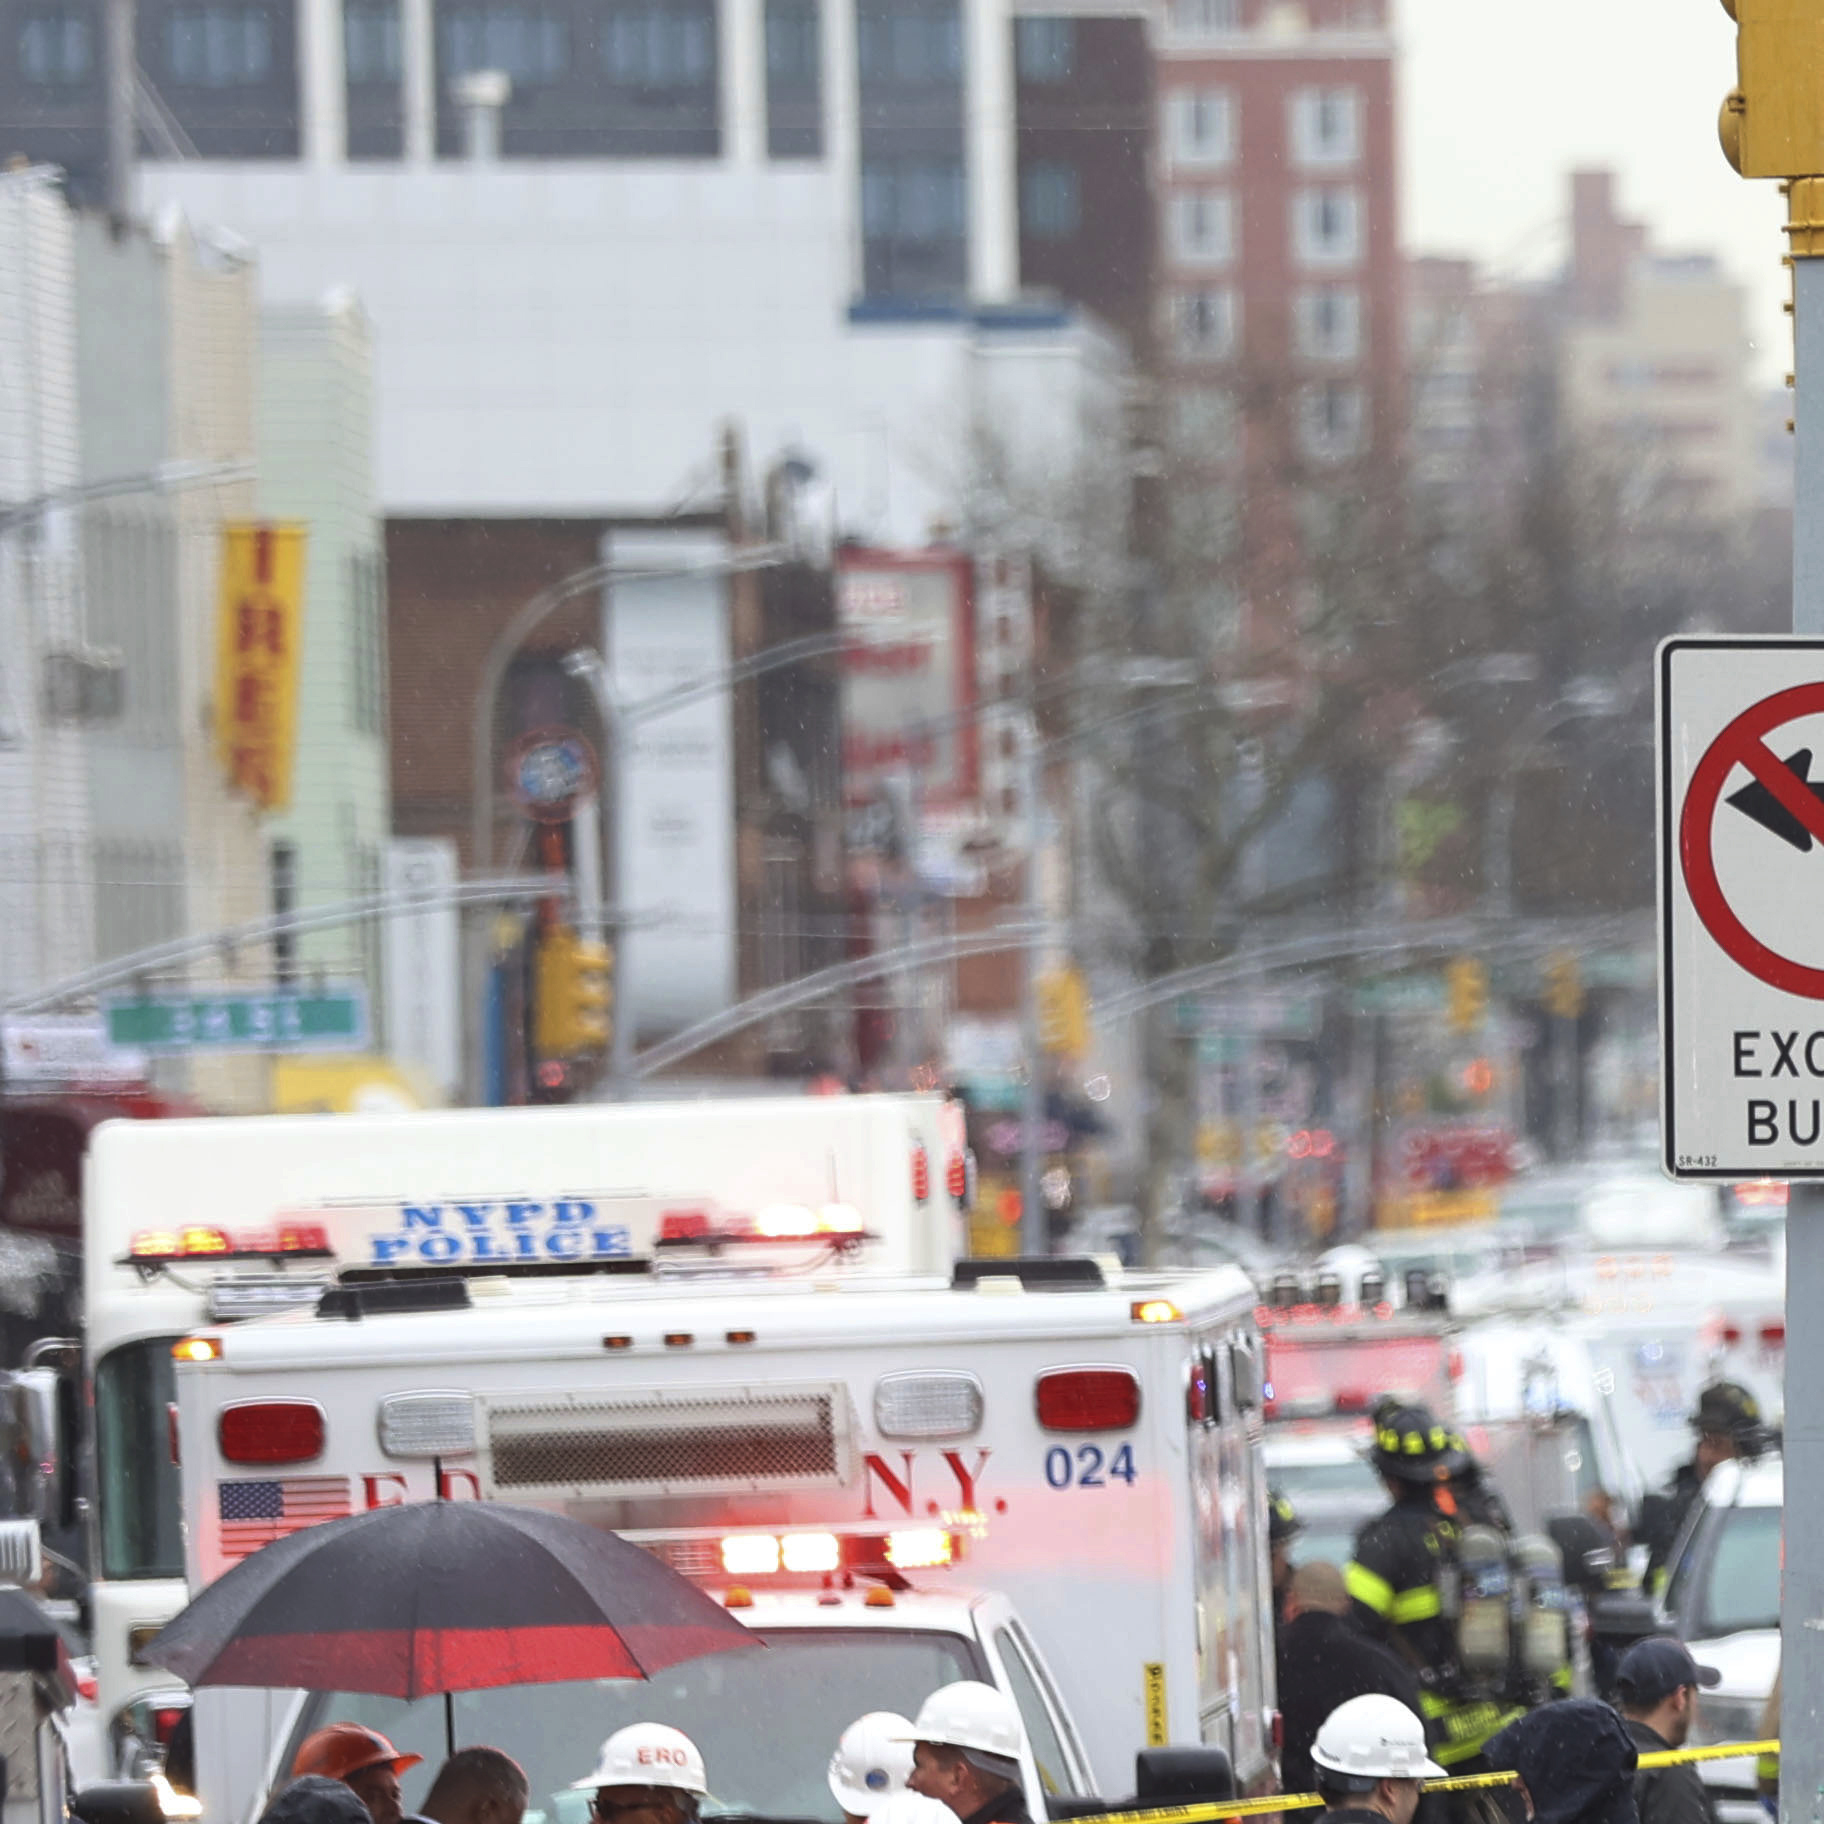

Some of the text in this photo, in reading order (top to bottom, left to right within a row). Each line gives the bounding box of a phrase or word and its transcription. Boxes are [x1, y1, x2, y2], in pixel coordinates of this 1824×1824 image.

[1678, 1154, 1718, 1168] SR-432
[403, 1198, 595, 1233] NYPD
[370, 1227, 632, 1267] POLICE
[1045, 1442, 1136, 1488] 024
[636, 1745, 687, 1768] ERO
